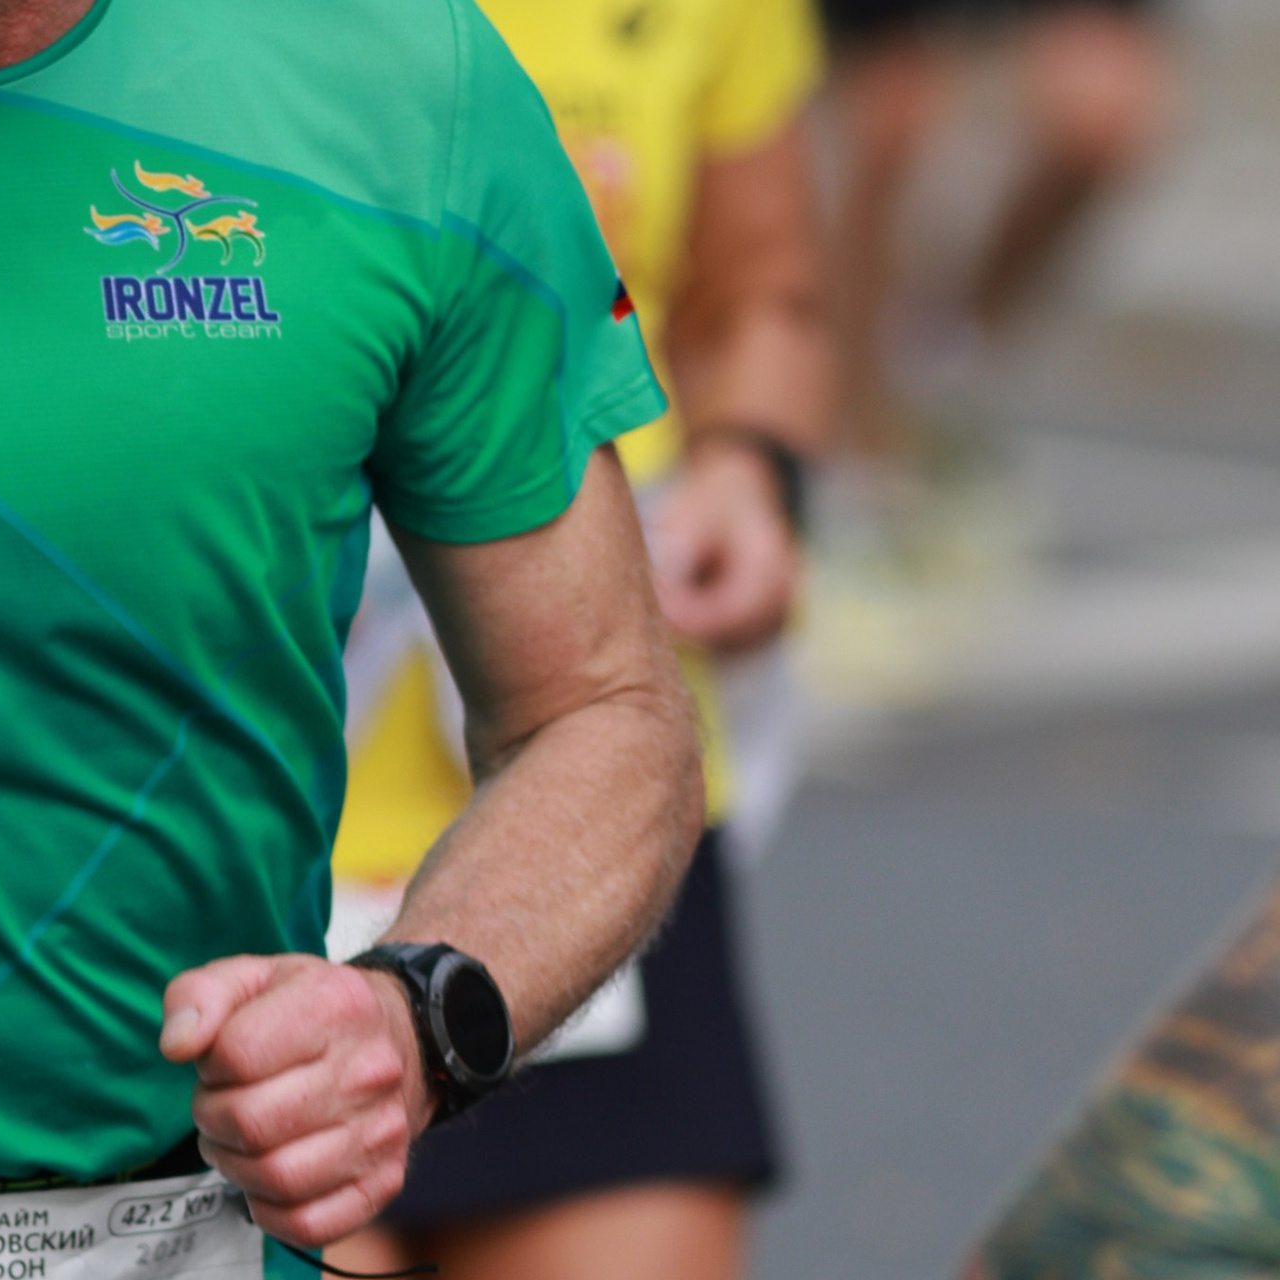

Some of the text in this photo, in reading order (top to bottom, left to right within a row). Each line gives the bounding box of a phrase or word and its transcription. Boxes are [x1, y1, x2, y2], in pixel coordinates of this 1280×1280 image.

[102, 276, 280, 322] IRONZEL
[106, 322, 281, 342] sport team
[121, 1199, 173, 1227] 42,2
